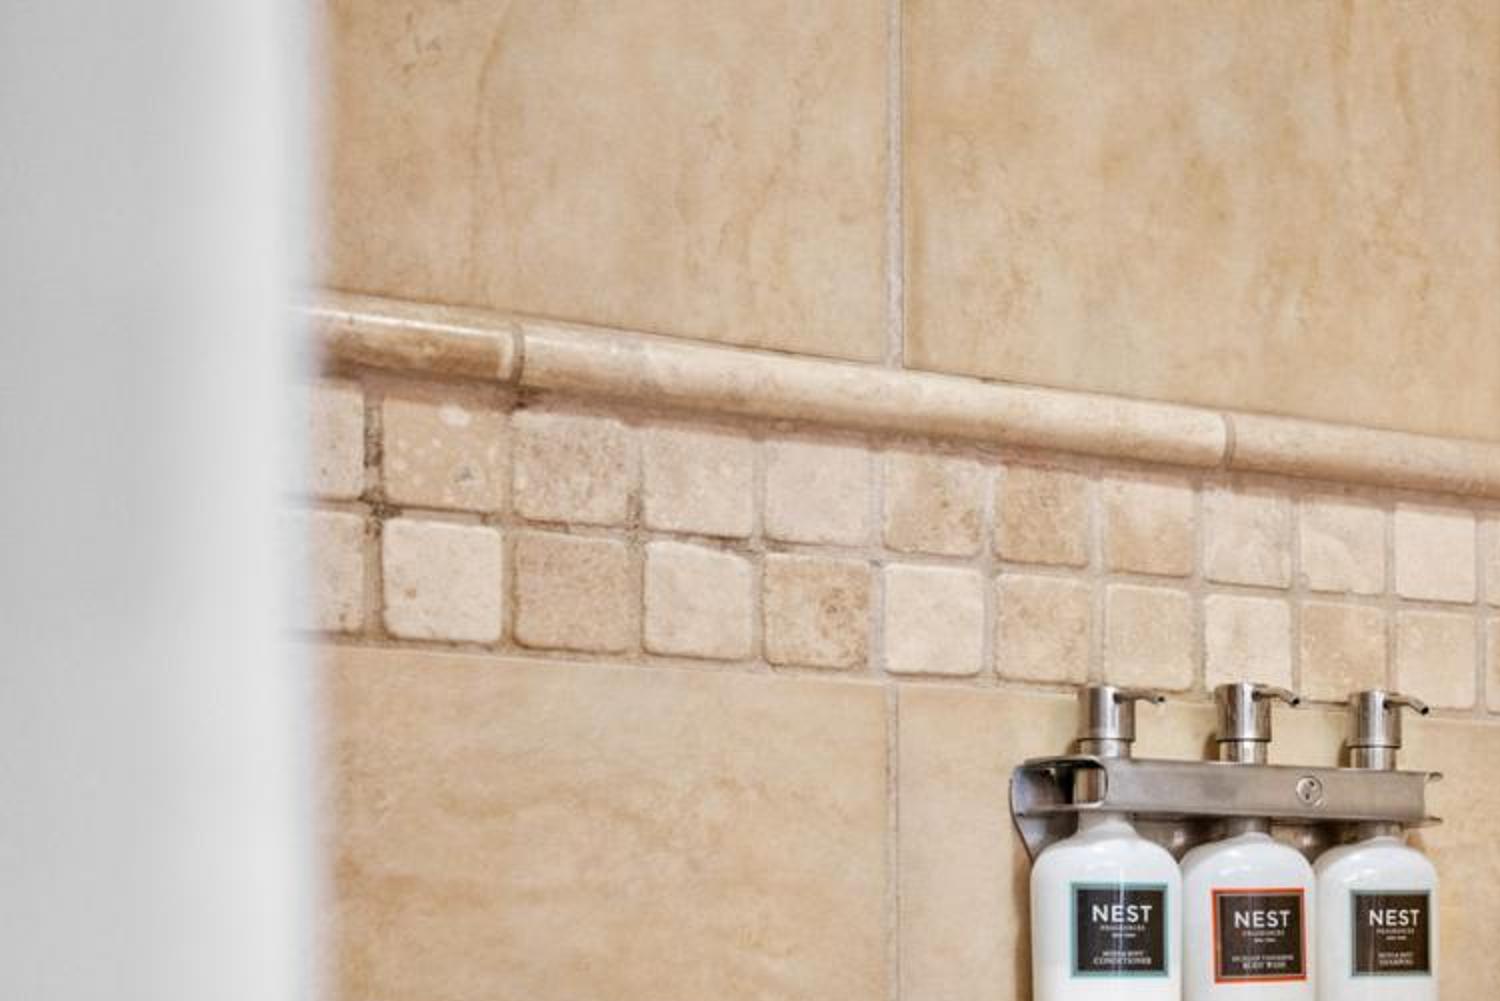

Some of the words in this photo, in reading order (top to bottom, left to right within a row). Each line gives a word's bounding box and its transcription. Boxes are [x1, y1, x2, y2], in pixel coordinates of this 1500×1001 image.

[1091, 903, 1153, 923] NEST
[1233, 909, 1292, 928] NEST
[1368, 908, 1420, 926] NEST
